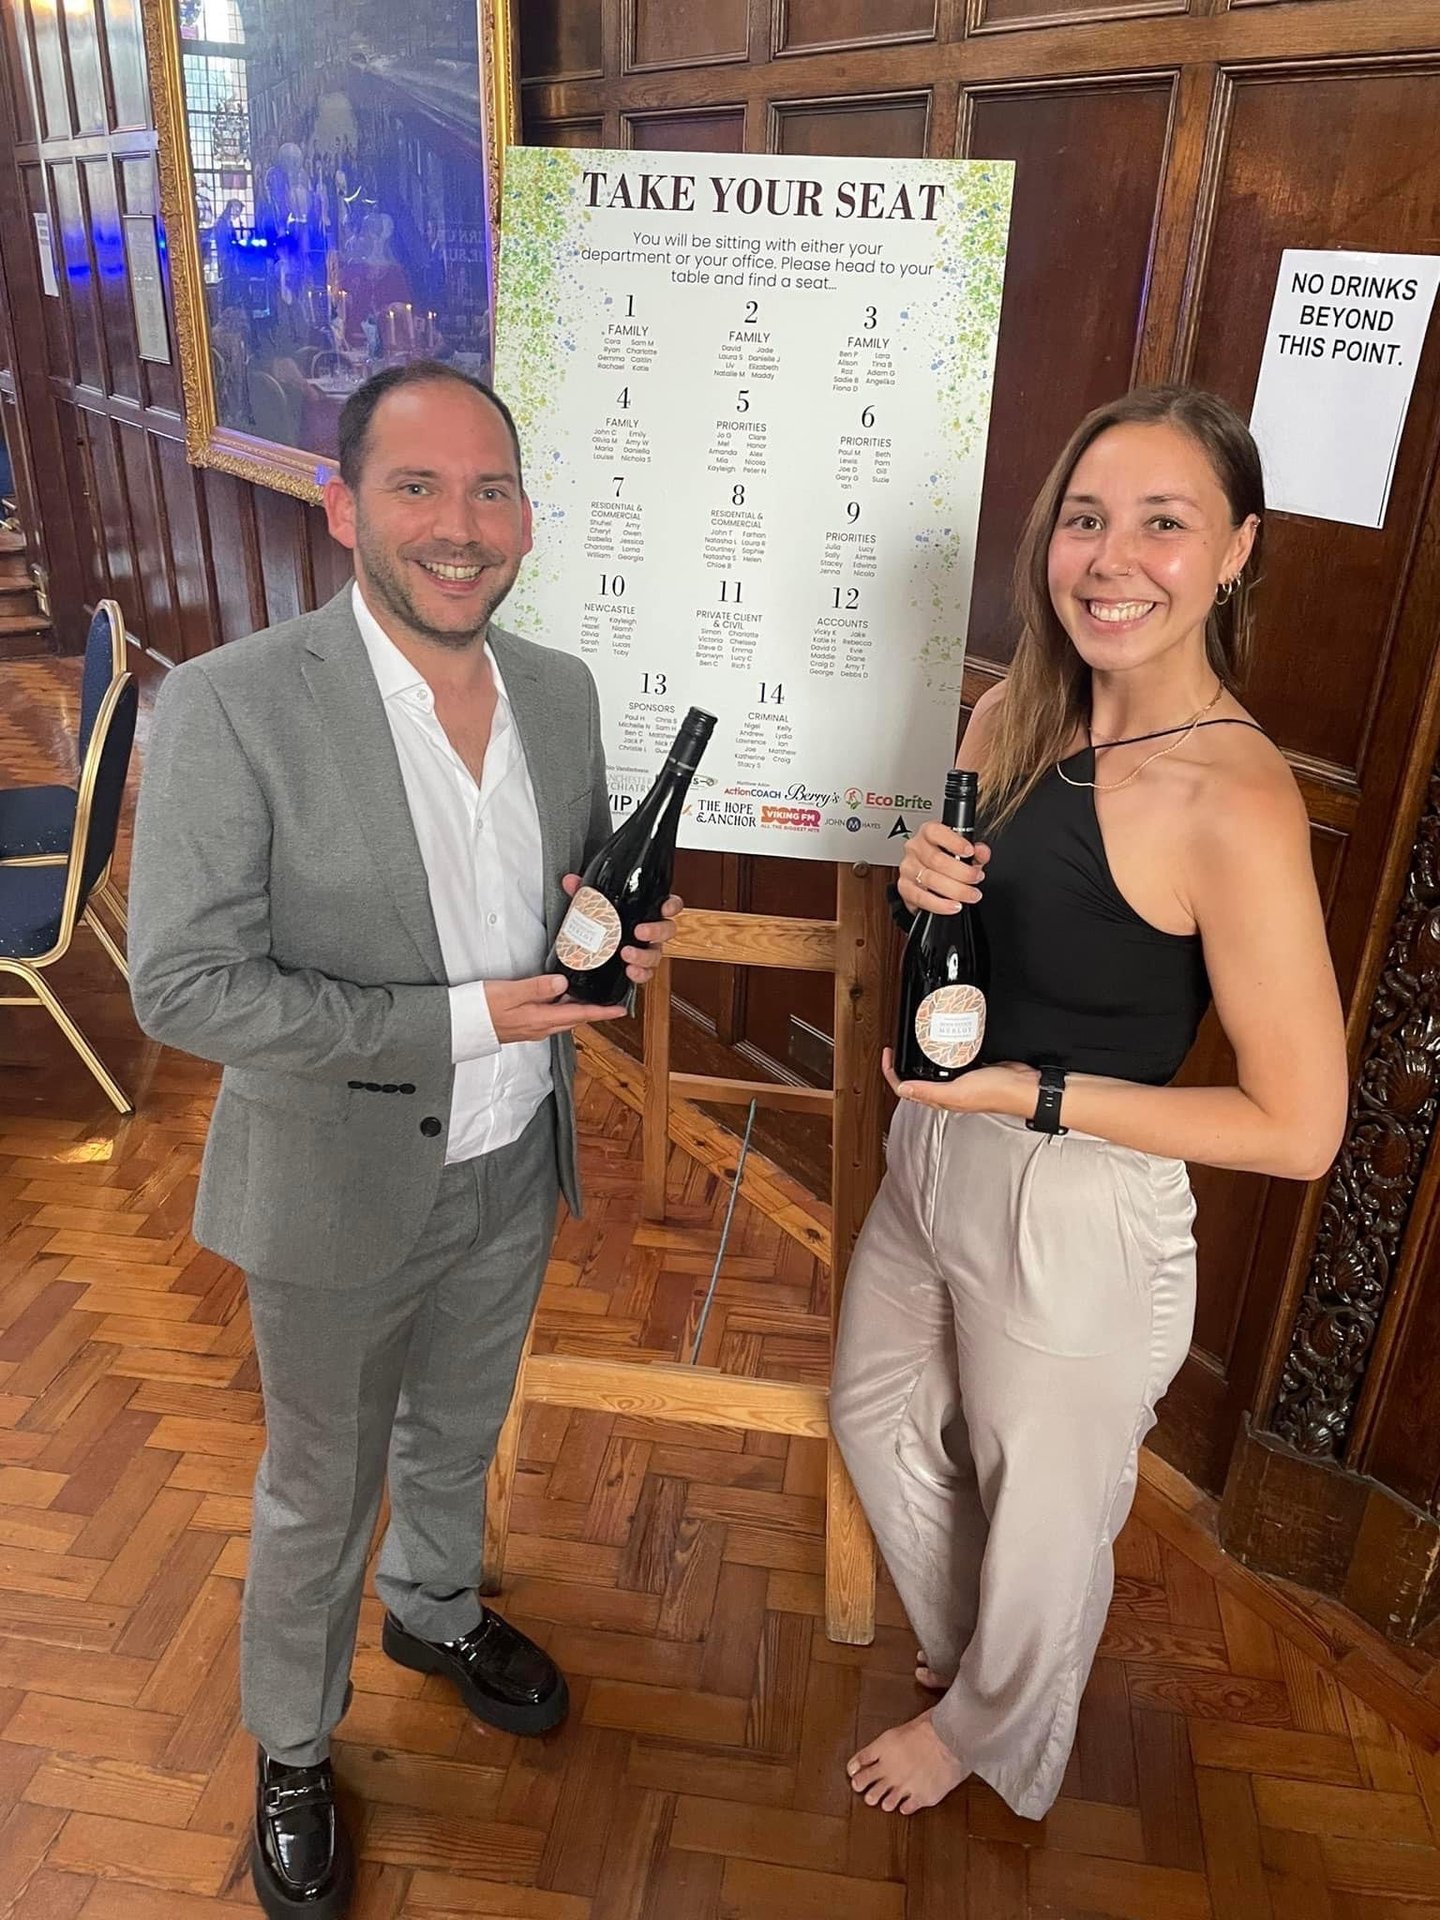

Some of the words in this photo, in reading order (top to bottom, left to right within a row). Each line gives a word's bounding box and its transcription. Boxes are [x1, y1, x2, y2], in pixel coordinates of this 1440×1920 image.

[583, 171, 696, 211] TAKE
[709, 177, 823, 217] YOUR
[835, 181, 945, 221] SEAT
[633, 232, 661, 247] You
[665, 234, 688, 247] will
[692, 234, 711, 249] be
[715, 236, 761, 252] sitting
[765, 237, 796, 252] with
[800, 239, 844, 254] either
[848, 241, 883, 257] your
[582, 248, 671, 266] department
[675, 253, 690, 265] or
[695, 255, 728, 269] your
[732, 255, 777, 270] office.
[781, 257, 831, 272] Please
[835, 260, 873, 274] head
[880, 262, 895, 274] to
[899, 262, 934, 278] your
[671, 270, 709, 285] table
[714, 272, 744, 286] and
[749, 272, 777, 287] find
[781, 276, 792, 288] a
[796, 276, 837, 291] seat...
[1292, 273, 1324, 294] NO
[1331, 275, 1418, 301] DRINKS
[625, 294, 635, 317] 1
[744, 301, 758, 323] 2
[864, 306, 877, 329] 3
[1300, 305, 1394, 331] BEYOND
[608, 324, 649, 336] FAMILY
[729, 331, 770, 343] FAMILY
[848, 337, 889, 349] FAMILY
[1279, 334, 1325, 358] THIS
[1332, 339, 1403, 366] POINT.
[616, 386, 631, 409] 4
[737, 390, 749, 413] 5
[606, 418, 639, 428] FAMILY
[717, 421, 767, 432] PRIORITIES
[862, 405, 875, 428] 6
[840, 436, 892, 448] PRIORITIES
[613, 476, 624, 497] 7
[732, 484, 745, 505] 8
[591, 501, 635, 511] RESIDENTIAL
[591, 510, 641, 520] COMMERCIAL
[711, 510, 756, 519] RESIDENTIAL
[847, 502, 860, 524] 9
[711, 519, 762, 528] COMMERCIAL
[826, 532, 876, 543] PRIORITIES
[599, 574, 625, 597] 10
[718, 580, 743, 603] 11
[584, 603, 636, 615] NEWCASTLE
[832, 587, 859, 610] 12
[696, 610, 731, 621] PRIVATE
[733, 613, 763, 623] CLIENT
[723, 620, 744, 630] CIVIL
[817, 618, 869, 628] ACCOUNTS
[641, 672, 667, 695] 13
[758, 682, 784, 705] 14
[629, 702, 675, 713] SPONSORS
[748, 712, 789, 723] CRIMINAL
[608, 794, 632, 811] IP
[724, 787, 781, 799] ActionCOACH
[784, 782, 840, 808] Berry's
[698, 800, 720, 811] THE
[725, 802, 753, 815] HOPE
[767, 810, 799, 819] VIKING
